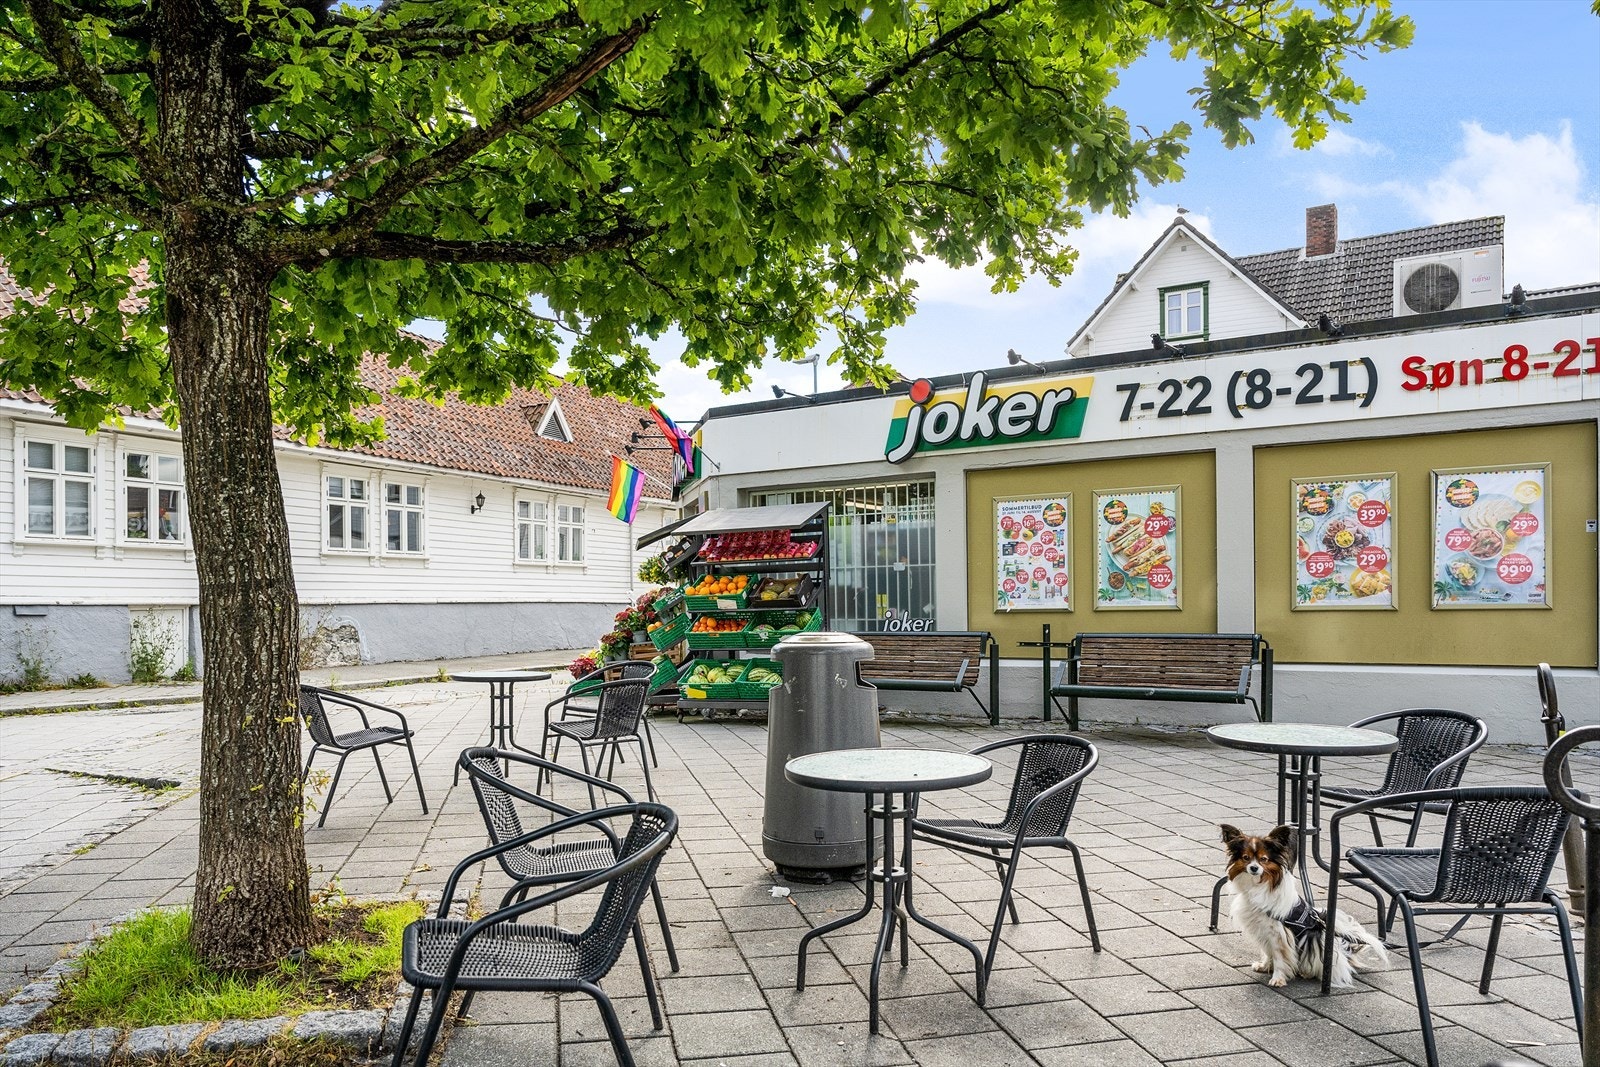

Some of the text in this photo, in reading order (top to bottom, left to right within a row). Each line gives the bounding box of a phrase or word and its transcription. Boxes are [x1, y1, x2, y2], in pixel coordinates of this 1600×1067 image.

[1471, 275, 1491, 283] FUJITSU
[1117, 376, 1211, 421] 7-22
[1227, 357, 1379, 419] (8-21)
[1401, 355, 1484, 391] Søn
[886, 372, 1076, 463] joker
[1148, 573, 1171, 583] -30%
